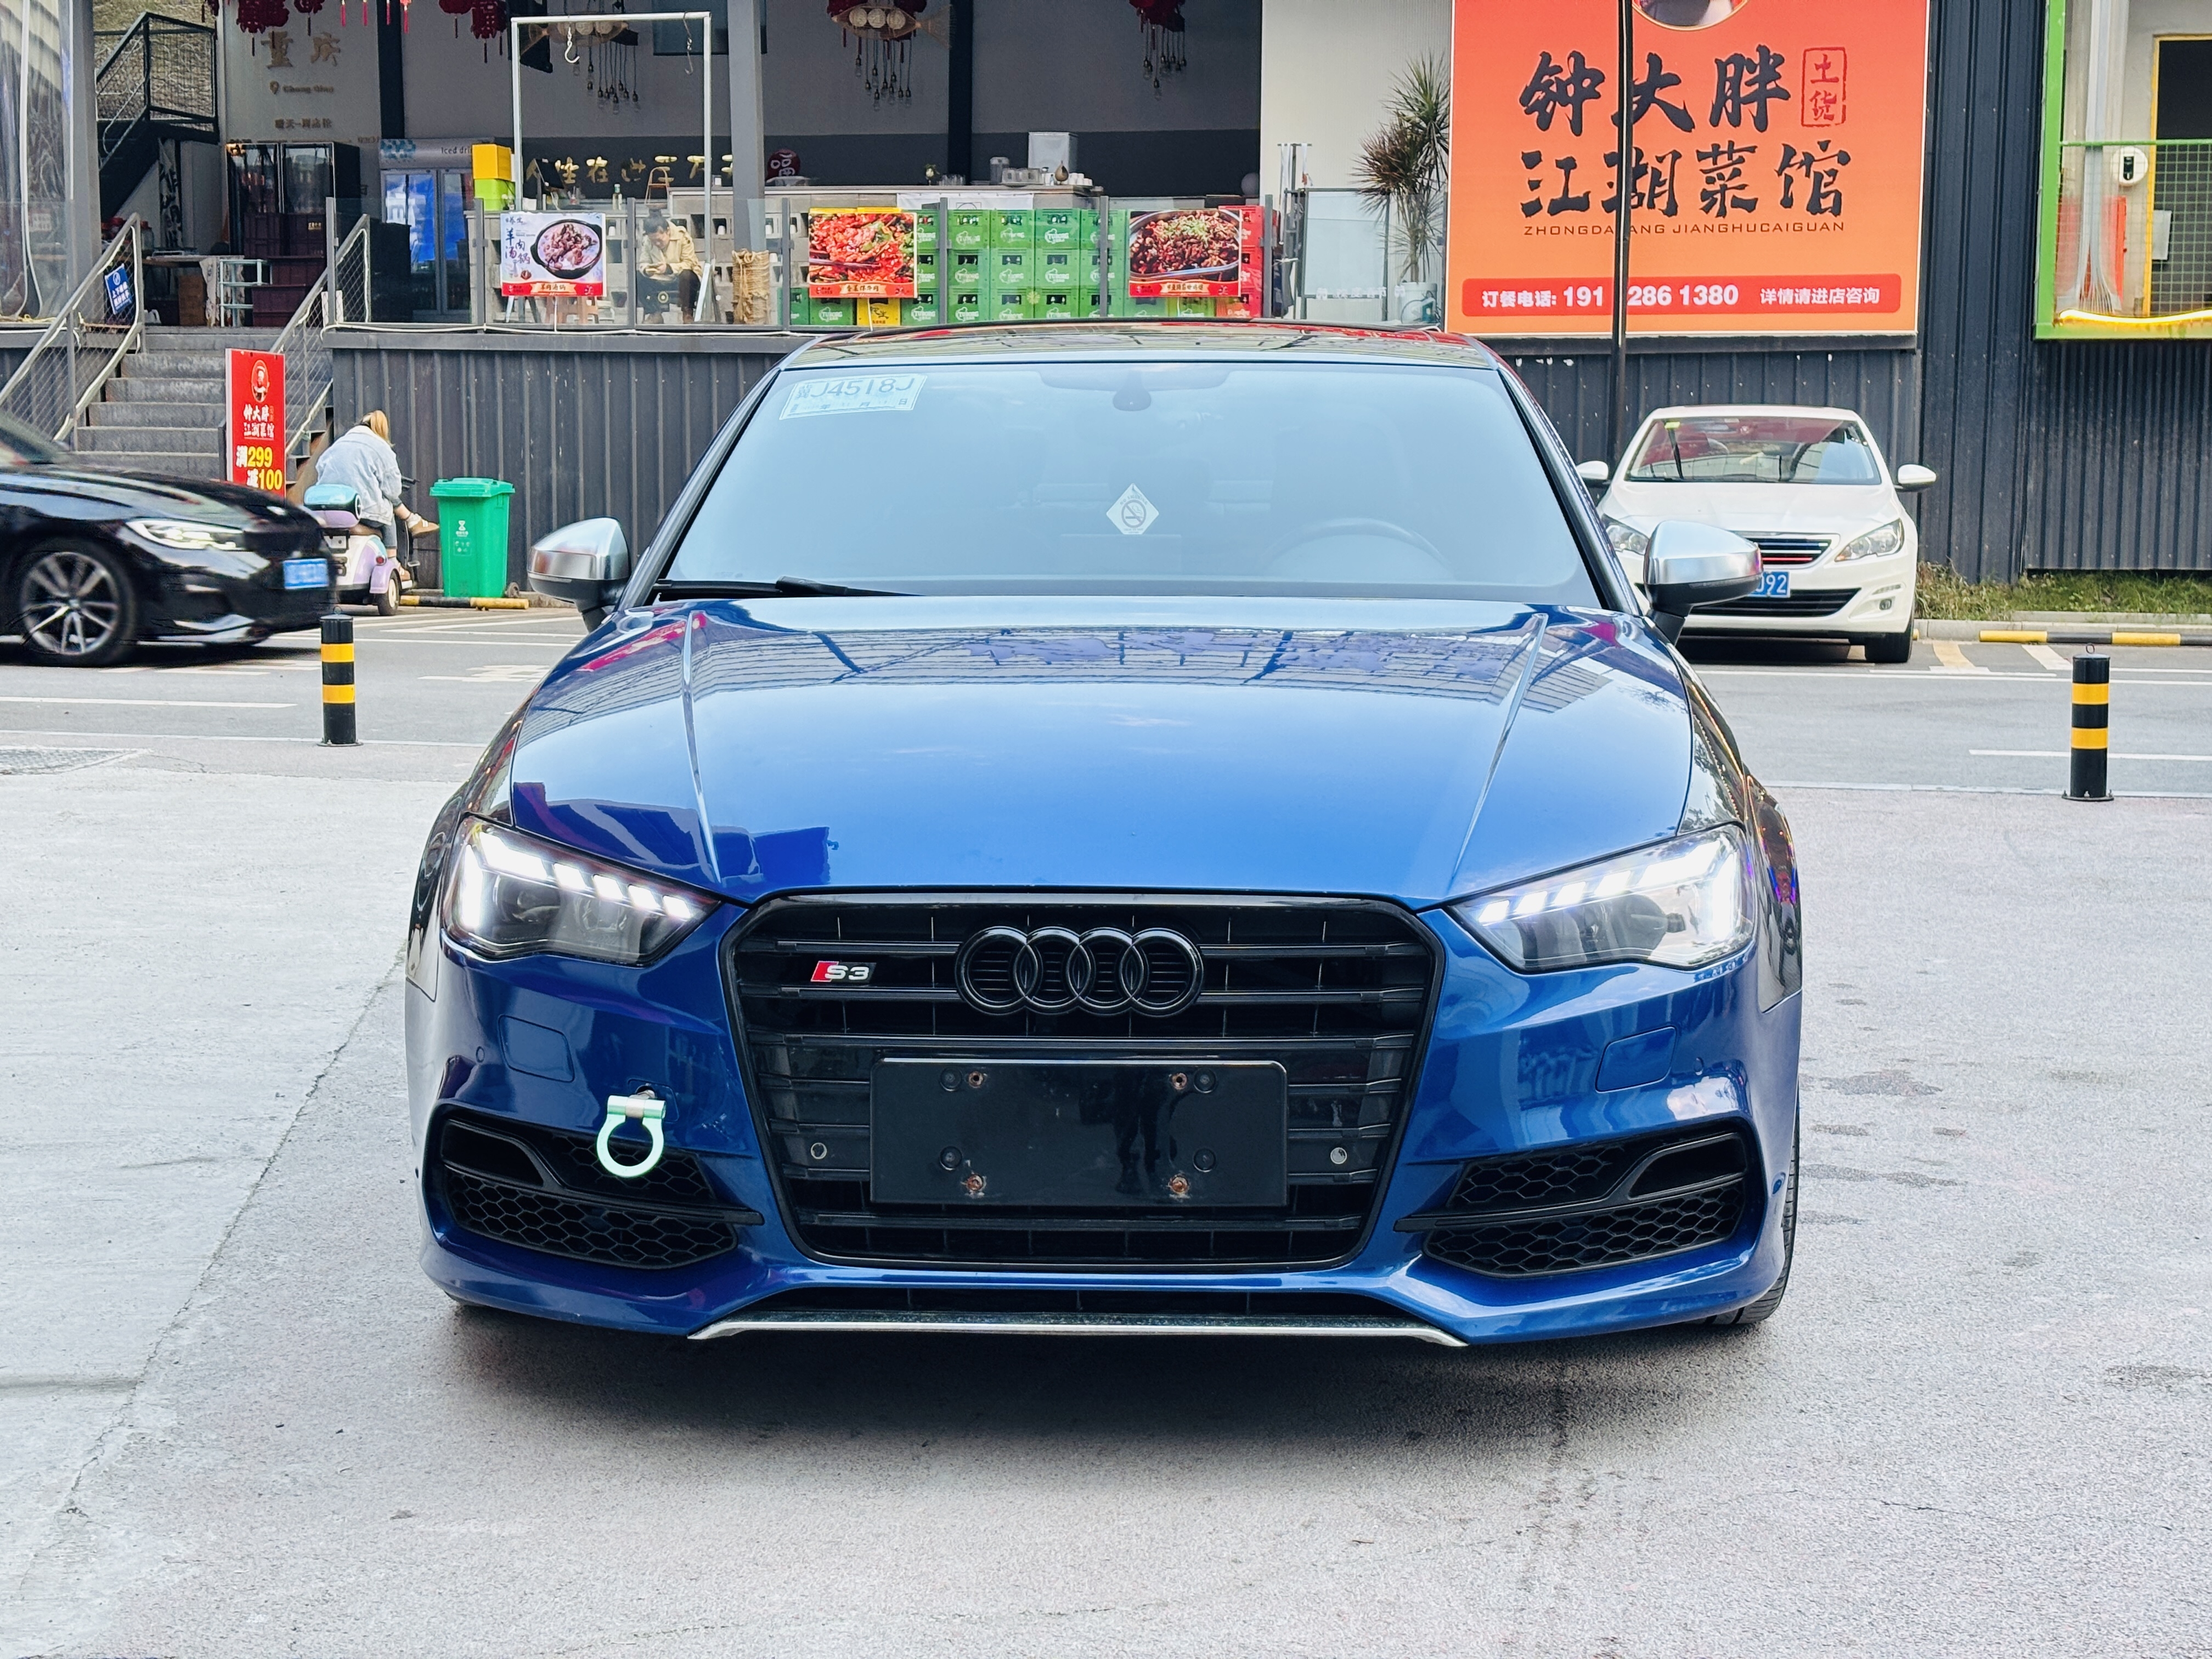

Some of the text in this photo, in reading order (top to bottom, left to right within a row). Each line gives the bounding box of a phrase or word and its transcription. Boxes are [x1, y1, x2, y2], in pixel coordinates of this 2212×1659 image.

[1519, 44, 1792, 137] 钟大胖
[1809, 54, 1839, 122] 土货
[1520, 140, 1851, 218] 江湖菜馆
[1524, 222, 1844, 235] ZHONGDAANG JIANGHUCAIGUAN
[1482, 284, 1739, 307] 订餐电话: 191 286 1380
[1760, 287, 1880, 305] 详情请进店咨询
[236, 445, 273, 468] 满299
[246, 468, 283, 490] 减100
[825, 965, 870, 980] S3
